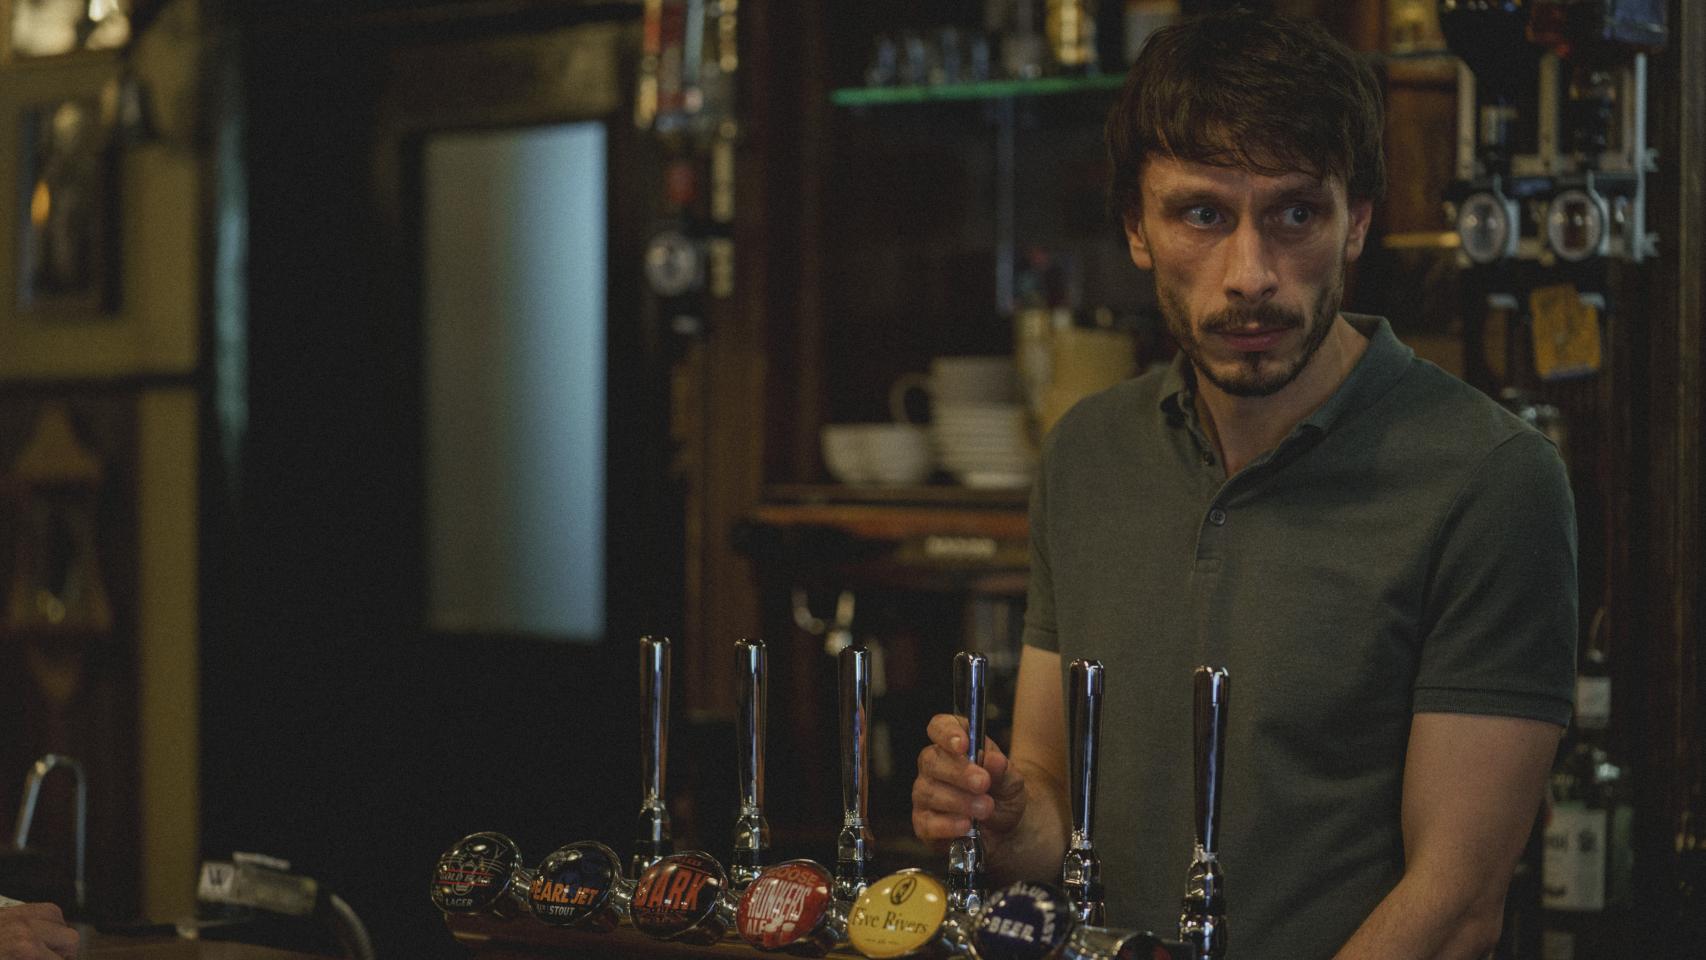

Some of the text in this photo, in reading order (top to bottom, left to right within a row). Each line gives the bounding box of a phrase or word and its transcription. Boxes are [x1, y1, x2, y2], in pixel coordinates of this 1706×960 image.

[445, 897, 473, 908] LAGER
[571, 886, 600, 906] JET
[549, 904, 576, 917] STOUT
[746, 918, 768, 936] ALE
[882, 910, 928, 934] Rivers
[987, 915, 1035, 943] BEER
